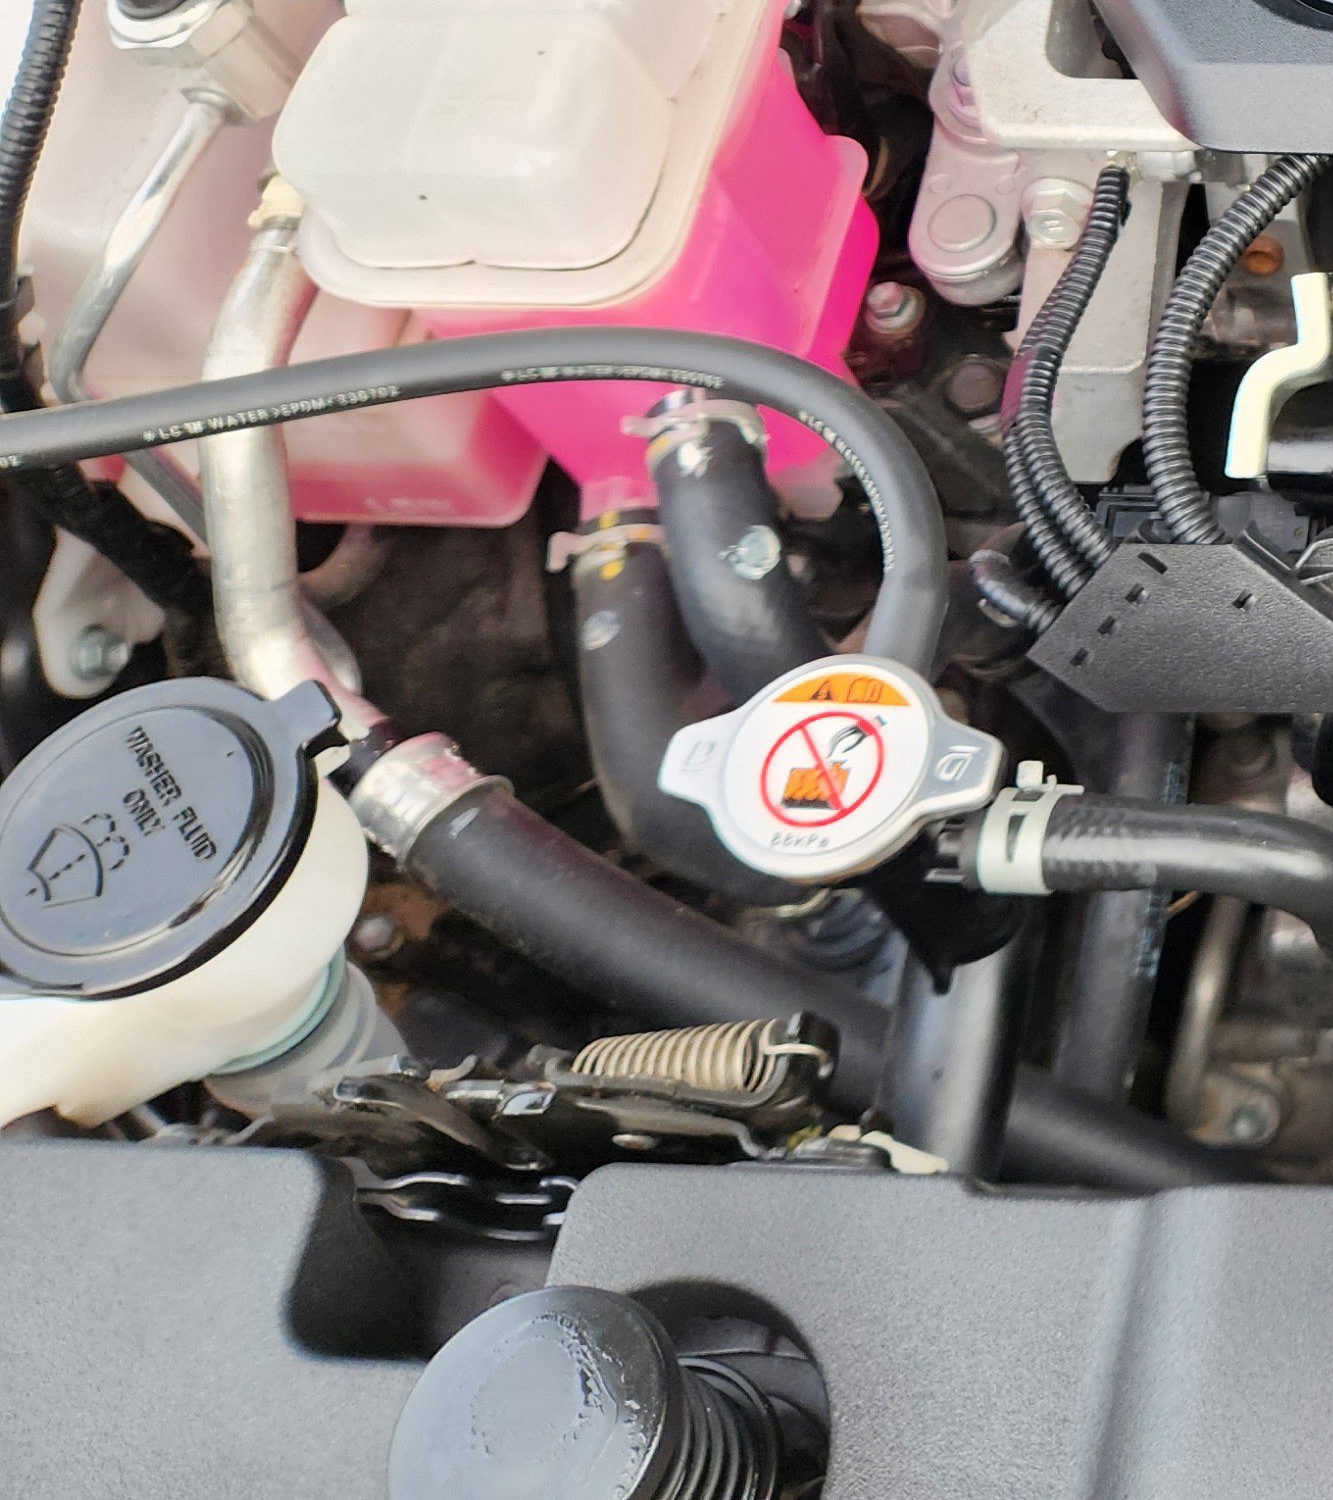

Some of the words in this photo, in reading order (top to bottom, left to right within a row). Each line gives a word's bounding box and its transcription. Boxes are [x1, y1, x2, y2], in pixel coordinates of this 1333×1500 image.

[208, 407, 269, 430] WATER
[122, 788, 165, 836] ONLY
[125, 725, 182, 807] WASHER
[173, 806, 217, 860] FLUID
